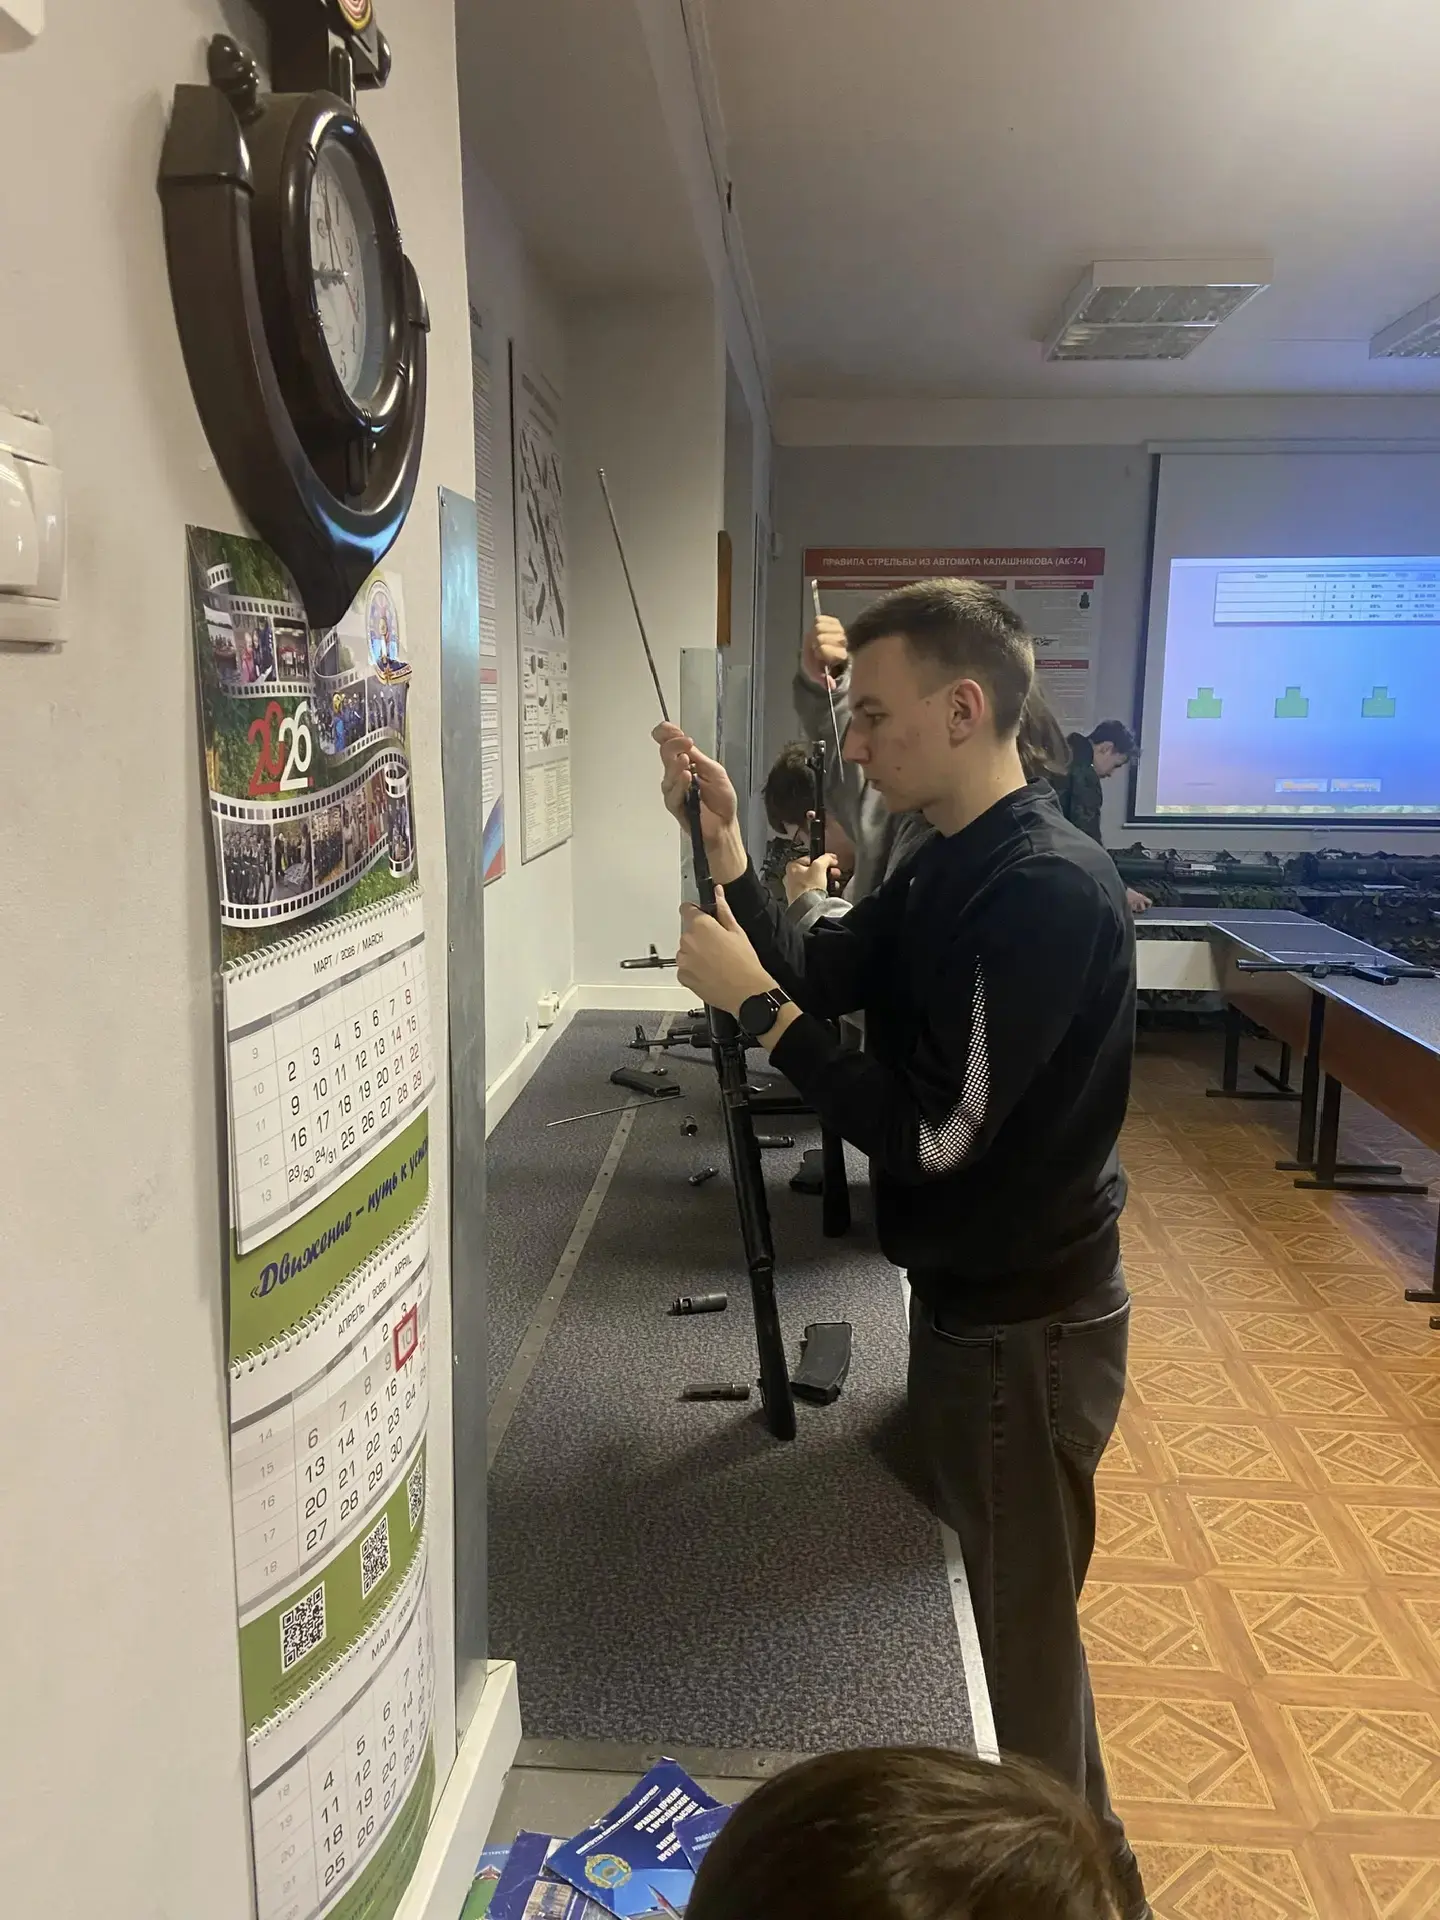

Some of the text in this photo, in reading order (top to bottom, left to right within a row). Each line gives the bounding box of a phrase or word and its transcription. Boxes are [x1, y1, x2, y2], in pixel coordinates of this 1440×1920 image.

[822, 556, 1087, 567] ПРАВИЛА СТРЕЛЬБЫ ИЗ АВТОМАТА КАЛАШНИКОВА (АК-74)
[247, 700, 312, 797] 2026
[313, 955, 333, 975] МАРТ
[361, 931, 384, 951] MARCH
[402, 960, 407, 976] 1
[288, 1060, 297, 1082] 2
[312, 1046, 321, 1066] 3
[334, 1033, 341, 1051] 4
[354, 1020, 362, 1039] 5
[372, 1009, 380, 1027] 6
[390, 998, 396, 1016] 7
[404, 988, 412, 1005] 8
[290, 1095, 300, 1116] 9
[312, 1077, 328, 1101] 10
[334, 1063, 347, 1086] 11
[354, 1050, 368, 1071] 12
[374, 1038, 386, 1058] 13
[390, 1025, 402, 1046] 14
[406, 1014, 417, 1034] 15
[288, 1164, 315, 1184] 23/30
[314, 1146, 338, 1164] 24/31
[340, 1126, 356, 1151] 25
[361, 1110, 376, 1134] 26
[380, 1096, 392, 1118] 27
[396, 1082, 408, 1104] 28
[412, 1070, 422, 1091] 29
[290, 1126, 308, 1152] 16
[316, 1110, 330, 1134] 17
[338, 1094, 352, 1116] 18
[358, 1080, 372, 1102] 19
[376, 1066, 390, 1090] 20
[394, 1055, 404, 1076] 21
[408, 1042, 420, 1063] 22
[249, 1211, 352, 1299] «Движение
[367, 1171, 398, 1213] путь
[338, 1302, 366, 1338] АПРЕЛЬ
[372, 1278, 387, 1300] 2026
[394, 1254, 413, 1278] APRIL
[362, 1346, 368, 1362] 1
[382, 1322, 389, 1342] 2
[304, 1456, 326, 1484] 13
[338, 1428, 356, 1455] 14
[364, 1402, 378, 1428] 15
[384, 1377, 398, 1402] 16
[404, 1354, 414, 1380] 17
[308, 1427, 318, 1450] 6
[338, 1400, 348, 1423] 7
[364, 1375, 372, 1396] 8
[384, 1351, 392, 1372] 9
[401, 1327, 412, 1350] 10
[305, 1487, 327, 1520] 20
[338, 1460, 356, 1490] 21
[366, 1432, 380, 1462] 22
[386, 1406, 400, 1434] 23
[404, 1383, 416, 1410] 24
[306, 1518, 328, 1552] 27
[340, 1489, 358, 1521] 28
[368, 1461, 383, 1492] 29
[390, 1435, 403, 1463] 30
[371, 1628, 392, 1662] МАЙ
[321, 1796, 340, 1824] 11
[354, 1758, 372, 1788] 12
[382, 1724, 396, 1752] 13
[402, 1690, 413, 1718] 14
[323, 1770, 335, 1792] 4
[356, 1734, 366, 1757] 5
[383, 1700, 390, 1722] 6
[404, 1667, 410, 1688] 7
[324, 1823, 343, 1854] 18
[356, 1786, 373, 1816] 19
[382, 1751, 397, 1784] 20
[402, 1720, 413, 1749] 21
[324, 1851, 346, 1888] 25
[357, 1814, 374, 1848] 26
[384, 1778, 397, 1812] 27
[634, 1786, 683, 1832] ПРАВИЛА ПРИЕМА
[650, 1794, 691, 1830] ЯРОСЛАВСКОЕ
[656, 1840, 682, 1862] ПРОТИВ
